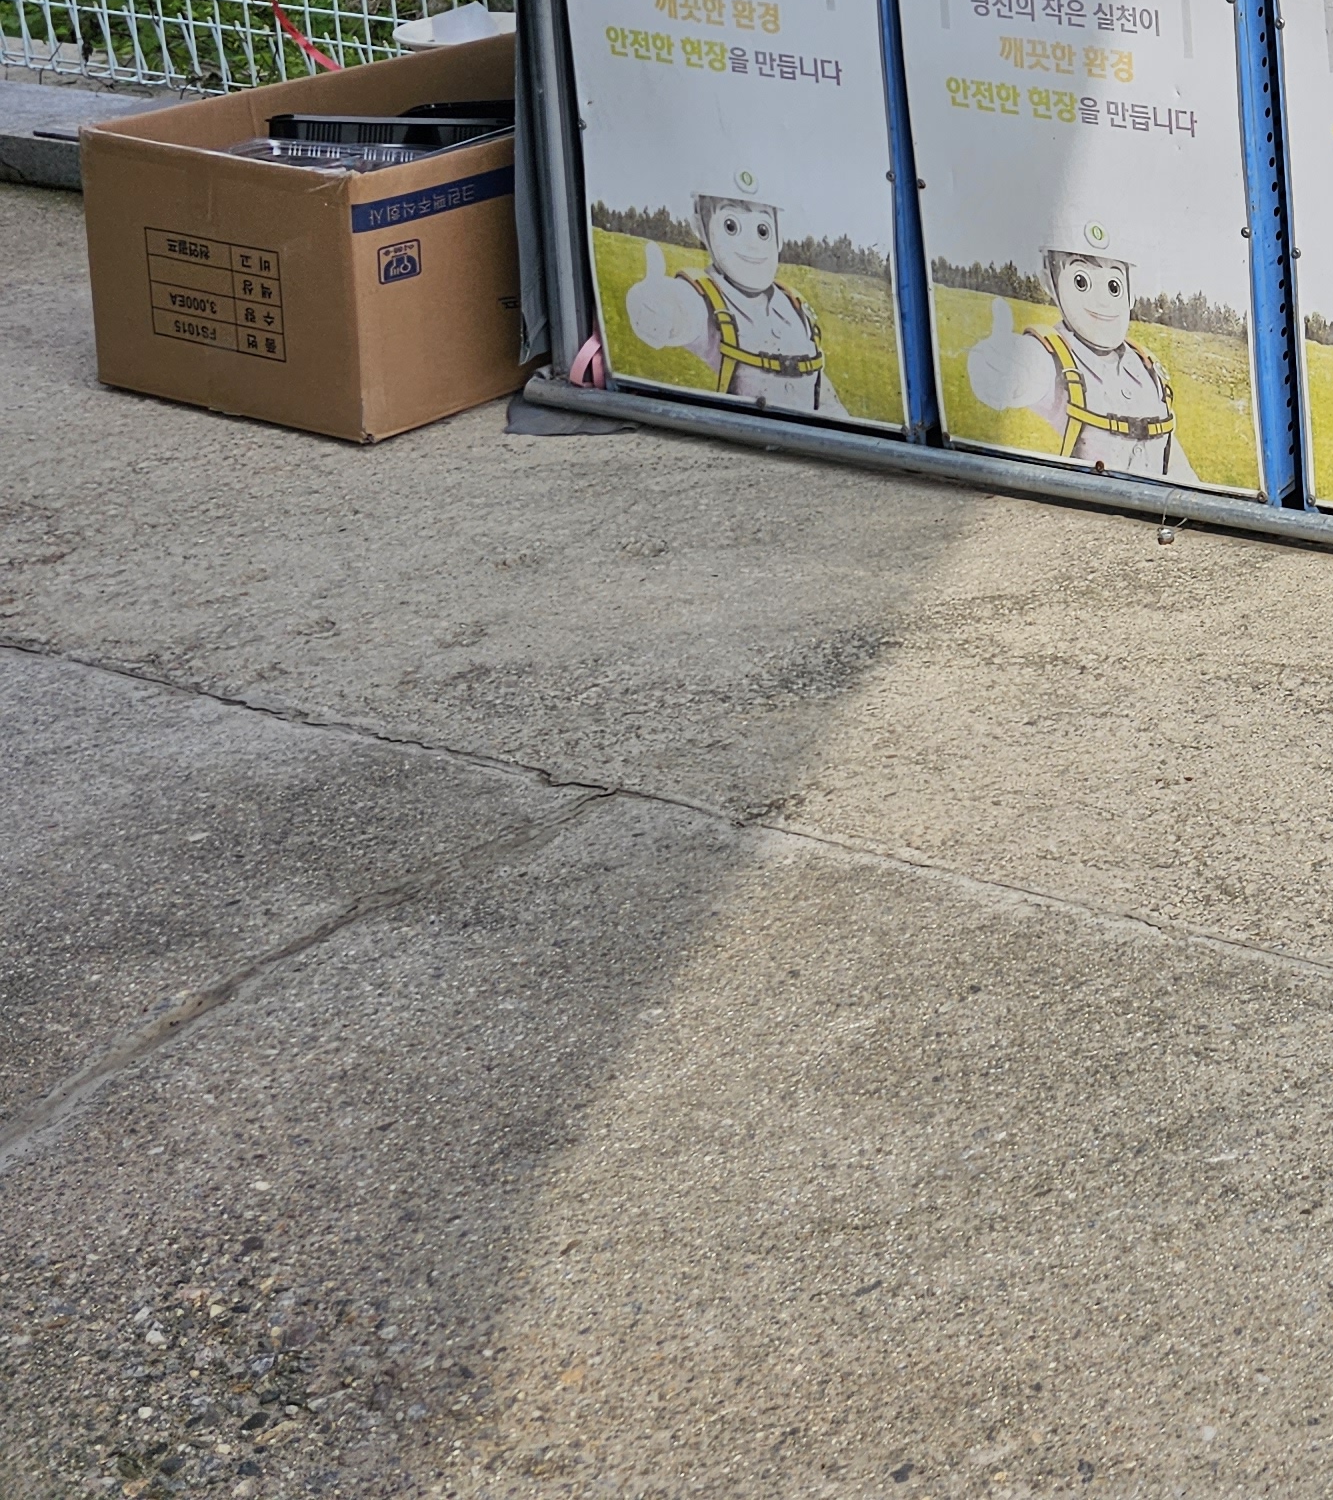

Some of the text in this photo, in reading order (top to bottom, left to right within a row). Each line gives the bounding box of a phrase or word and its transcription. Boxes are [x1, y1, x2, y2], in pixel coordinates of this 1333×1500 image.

[1093, 2, 1160, 37] 실천이
[605, 25, 842, 86] 안전한 현장을 만듭니다
[999, 36, 1134, 83] 깨끗한 환경
[945, 76, 1198, 137] 안전한 현장을 만듭니다
[174, 320, 216, 340] FS1015
